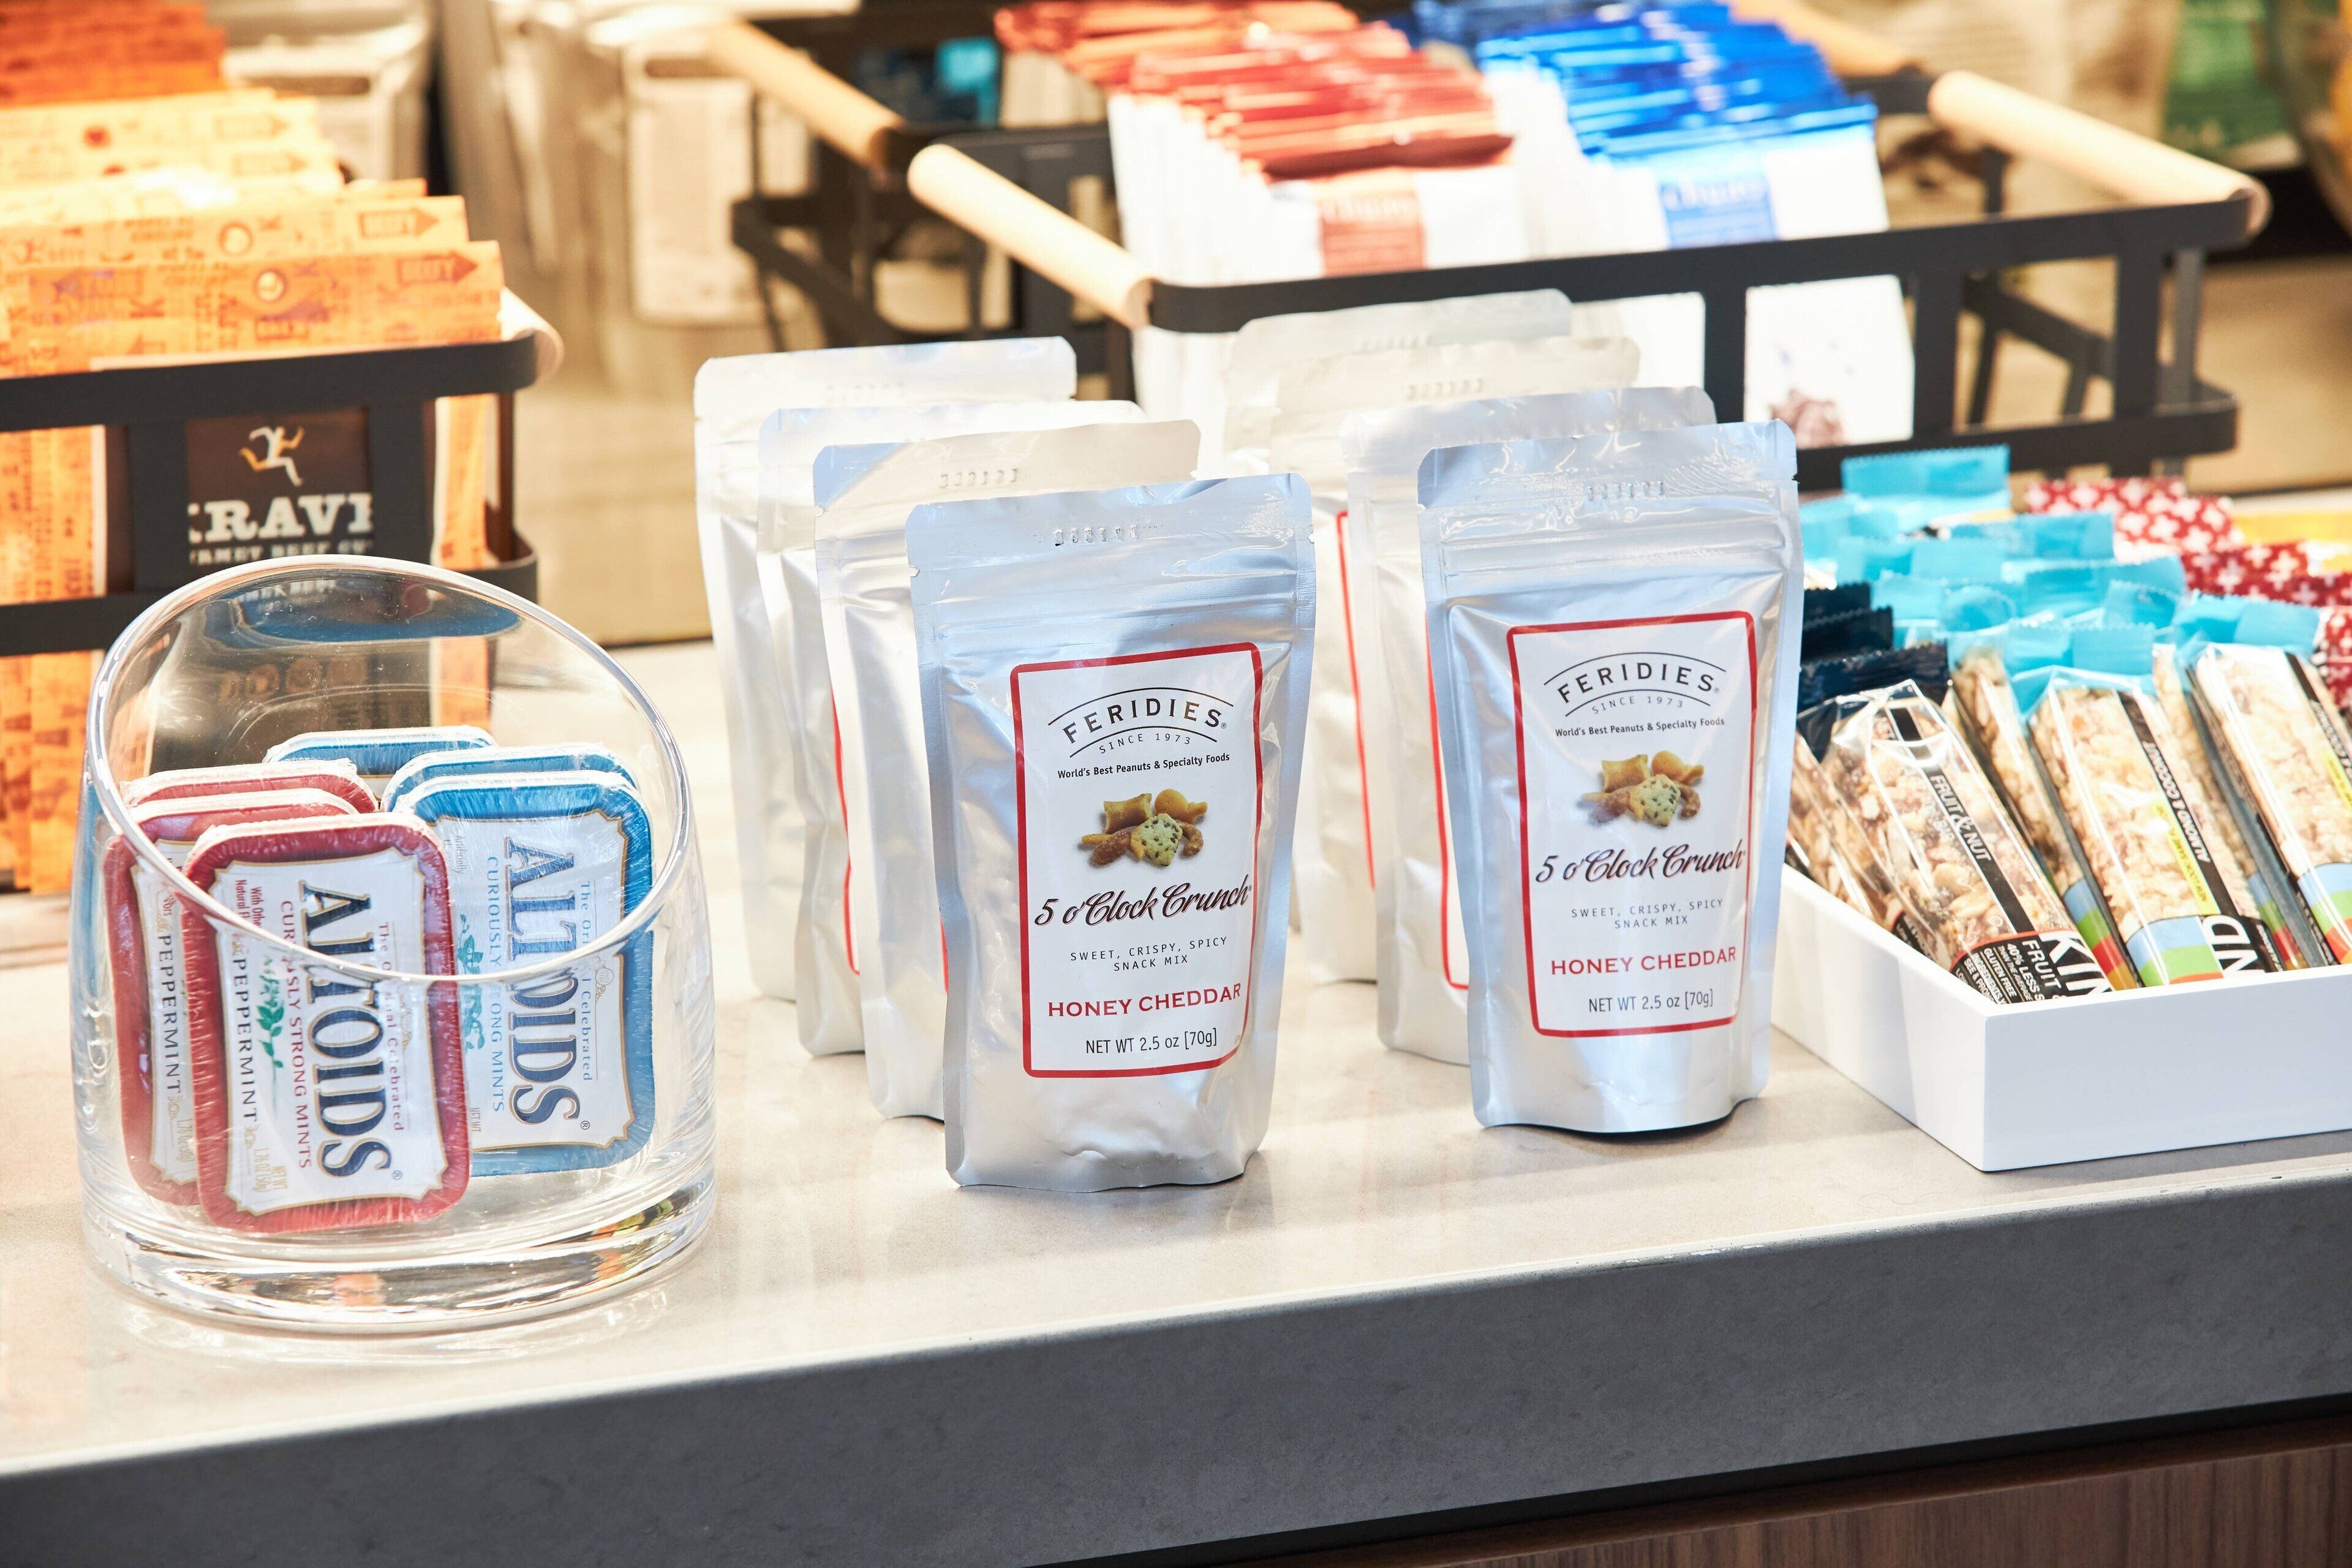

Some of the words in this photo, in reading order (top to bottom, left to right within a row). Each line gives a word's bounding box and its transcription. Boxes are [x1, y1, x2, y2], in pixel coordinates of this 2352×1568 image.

[1558, 662, 1714, 704] FERIDIES
[1063, 698, 1221, 744] FERIDIES
[1593, 696, 1635, 715] SINCE
[1647, 695, 1684, 708] 1973
[1099, 733, 1144, 754] SINCE
[1155, 733, 1191, 745] 1973
[1555, 726, 1585, 737] World's
[1588, 725, 1607, 735] Best
[1610, 722, 1645, 733] Peanuts
[1647, 722, 1654, 731] &
[1656, 718, 1697, 733] Specialty
[1700, 716, 1725, 727] Foods
[1058, 766, 1090, 779] World's
[1093, 764, 1114, 776] Best
[1116, 761, 1151, 774] Peanuts
[1154, 760, 1161, 770] &
[1163, 755, 1203, 771] Specialty
[1205, 752, 1230, 764] Foods
[1929, 775, 1961, 815] FRUIT
[1949, 814, 1974, 835] &
[1964, 832, 1991, 861] NUT
[1535, 855, 1558, 884] 5
[1562, 848, 1657, 884] o'Clock
[1662, 839, 1743, 878] Crunch
[235, 879, 251, 910] Natural
[249, 886, 263, 906] With
[486, 856, 500, 967] CURIOUSLY
[580, 881, 590, 910] The
[1034, 897, 1059, 925] 5
[1062, 889, 1156, 926] o'Clock
[1161, 874, 1250, 917] Crunch
[1572, 907, 1621, 918] SWEET,
[1629, 903, 1682, 916] CRISPY,
[1689, 898, 1724, 911] SPICY
[1614, 918, 1658, 930] SNACK
[1665, 915, 1689, 926] MIX
[1070, 950, 1120, 962] SWEET,
[1128, 943, 1180, 956] CRISPY,
[1189, 937, 1227, 949] SPICY
[1551, 956, 1634, 975] HONEY
[1641, 946, 1736, 971] CHEDDAR
[2203, 914, 2265, 975] ND
[1113, 959, 1157, 971] SNACK
[1164, 954, 1188, 966] MIX
[1963, 958, 1976, 974] SEE
[1983, 947, 2005, 978] GLUTEN
[2000, 977, 2018, 998] FREE
[2006, 944, 2024, 965] 40%
[2018, 966, 2041, 993] LESS
[2022, 940, 2062, 989] FRUIT
[2038, 930, 2114, 995] KIN
[156, 935, 181, 1094] PEPPERMINT
[1047, 998, 1130, 1017] HONEY
[1139, 982, 1241, 1012] CHEDDAR
[1589, 998, 1612, 1012] NET
[1618, 997, 1637, 1011] WT
[1642, 995, 1662, 1009] 2.5
[1666, 995, 1680, 1008] oz
[1684, 988, 1713, 1010] [70g]
[232, 959, 257, 1123] PEPPERMINT
[581, 990, 592, 1081] Celebrated
[1085, 1040, 1111, 1054] NET
[1115, 1038, 1134, 1052] WT
[1139, 1036, 1159, 1051] 2.5
[1164, 1036, 1179, 1048] oz
[1183, 1028, 1218, 1050] [70g]
[288, 1017, 307, 1098] STRONG
[491, 1051, 505, 1112] MINTS
[295, 1104, 312, 1169] MINTS
[271, 1166, 287, 1179] NET
[273, 1179, 288, 1191] WT
